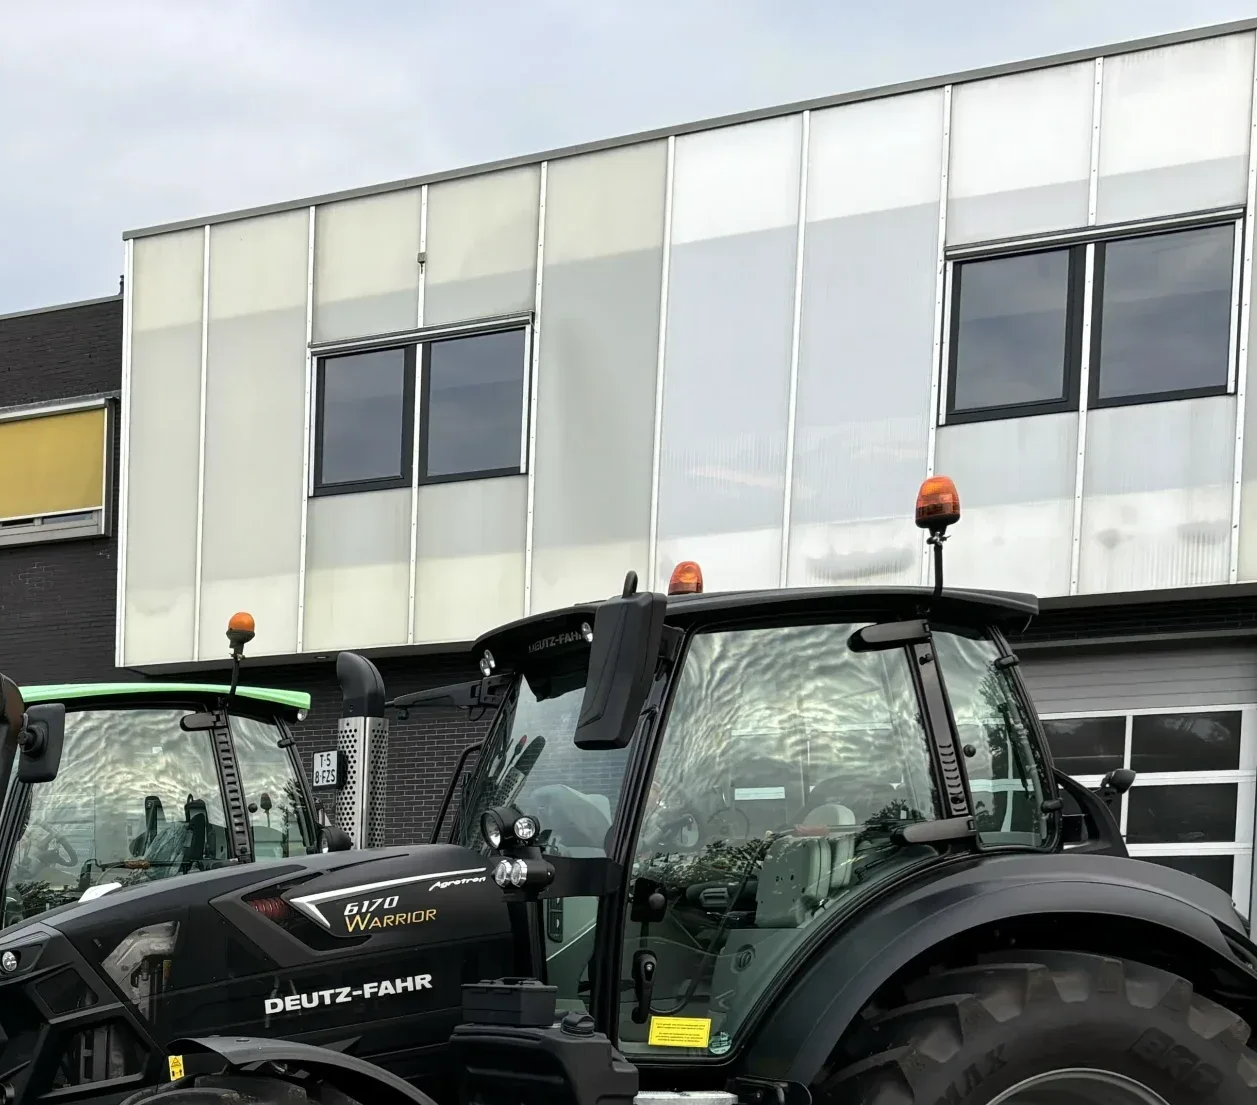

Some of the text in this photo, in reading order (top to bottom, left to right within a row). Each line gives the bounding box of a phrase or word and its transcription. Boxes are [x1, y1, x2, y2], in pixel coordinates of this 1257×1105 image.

[428, 876, 487, 892] Agrotron
[344, 895, 400, 916] 6170
[344, 908, 437, 933] WARRIOR
[264, 973, 433, 1015] DEUTZ-FAHR
